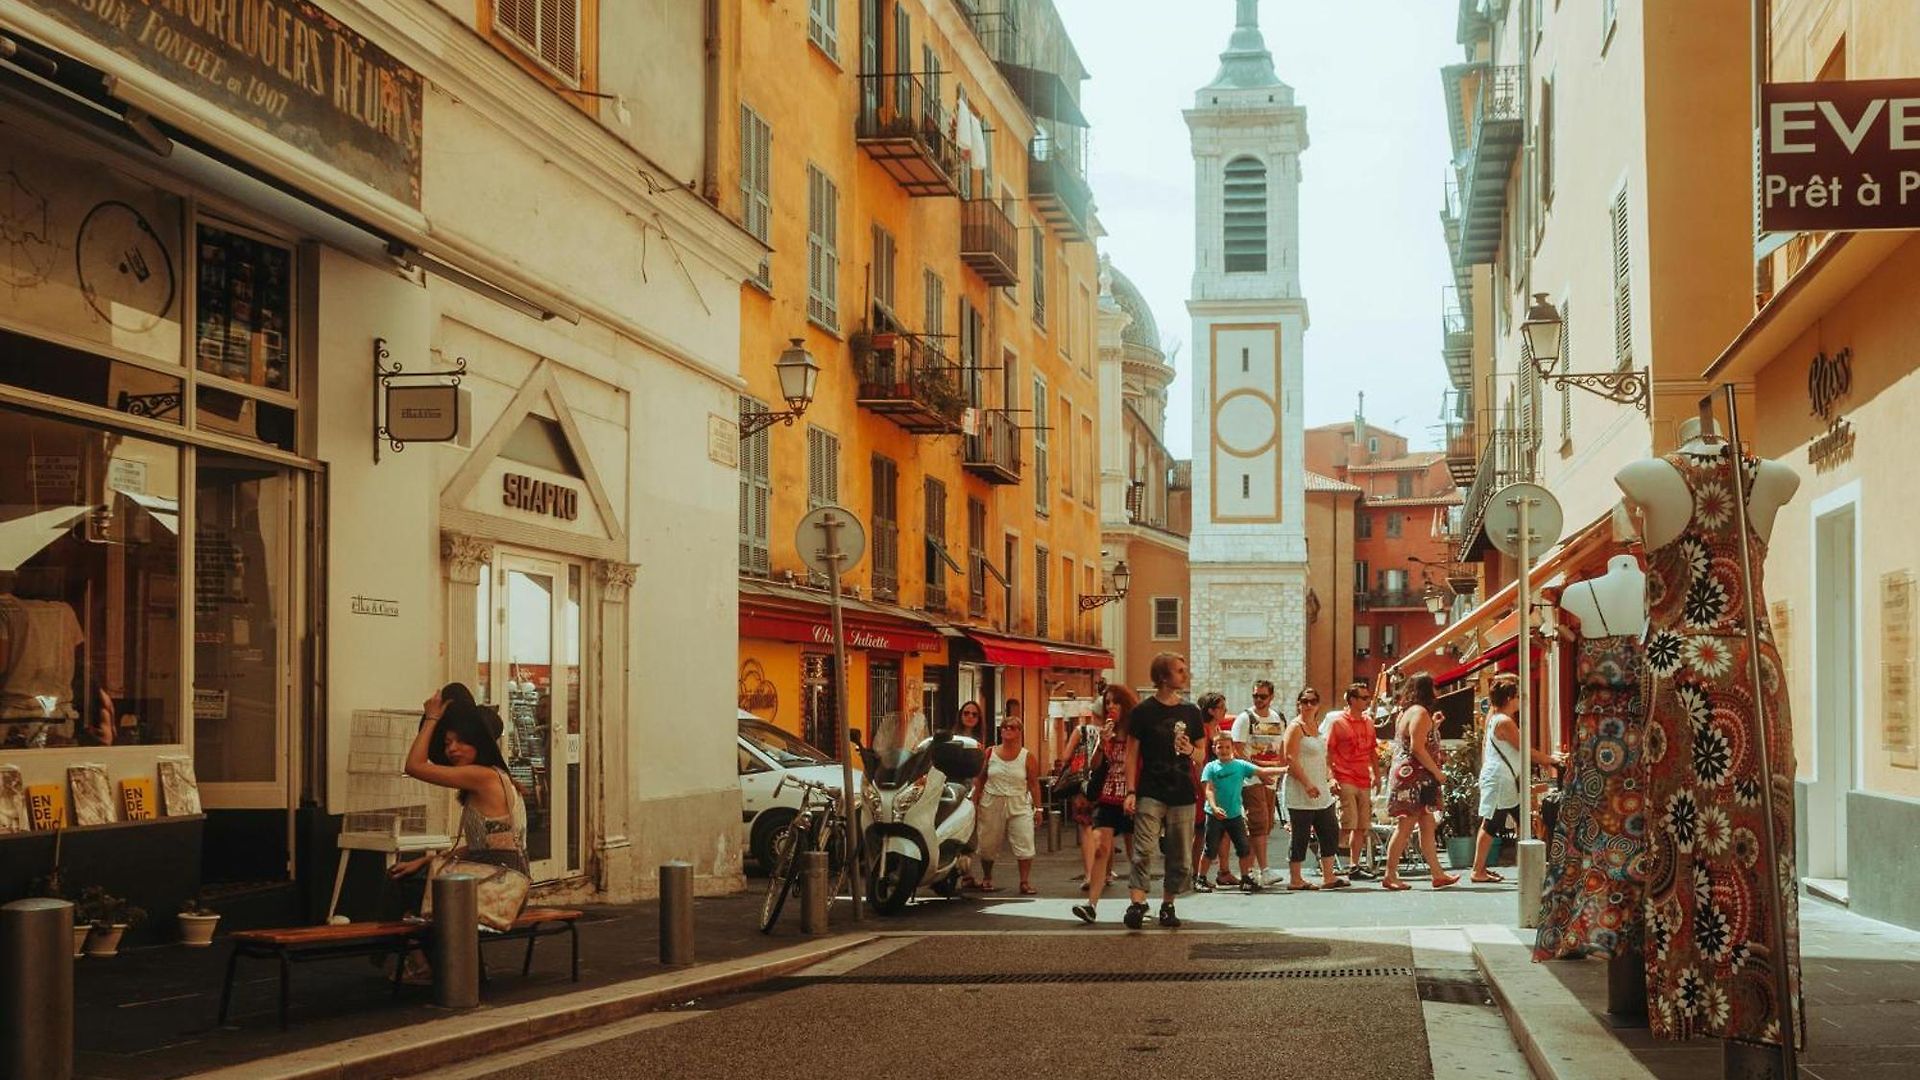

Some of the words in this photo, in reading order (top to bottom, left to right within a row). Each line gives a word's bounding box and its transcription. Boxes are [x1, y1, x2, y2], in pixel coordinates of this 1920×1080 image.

[159, 0, 324, 96] RLOGERS
[226, 77, 241, 95] en
[246, 76, 288, 117] 1907
[1770, 98, 1920, 154] EVE
[1766, 174, 1842, 208] Prêt
[1857, 173, 1881, 206] à
[1899, 171, 1920, 205] P
[503, 473, 577, 521] SHAPKO
[850, 629, 889, 648] Juliette
[33, 796, 51, 808] EN
[126, 788, 143, 800] EN
[127, 800, 144, 811] DE
[34, 808, 52, 820] DE
